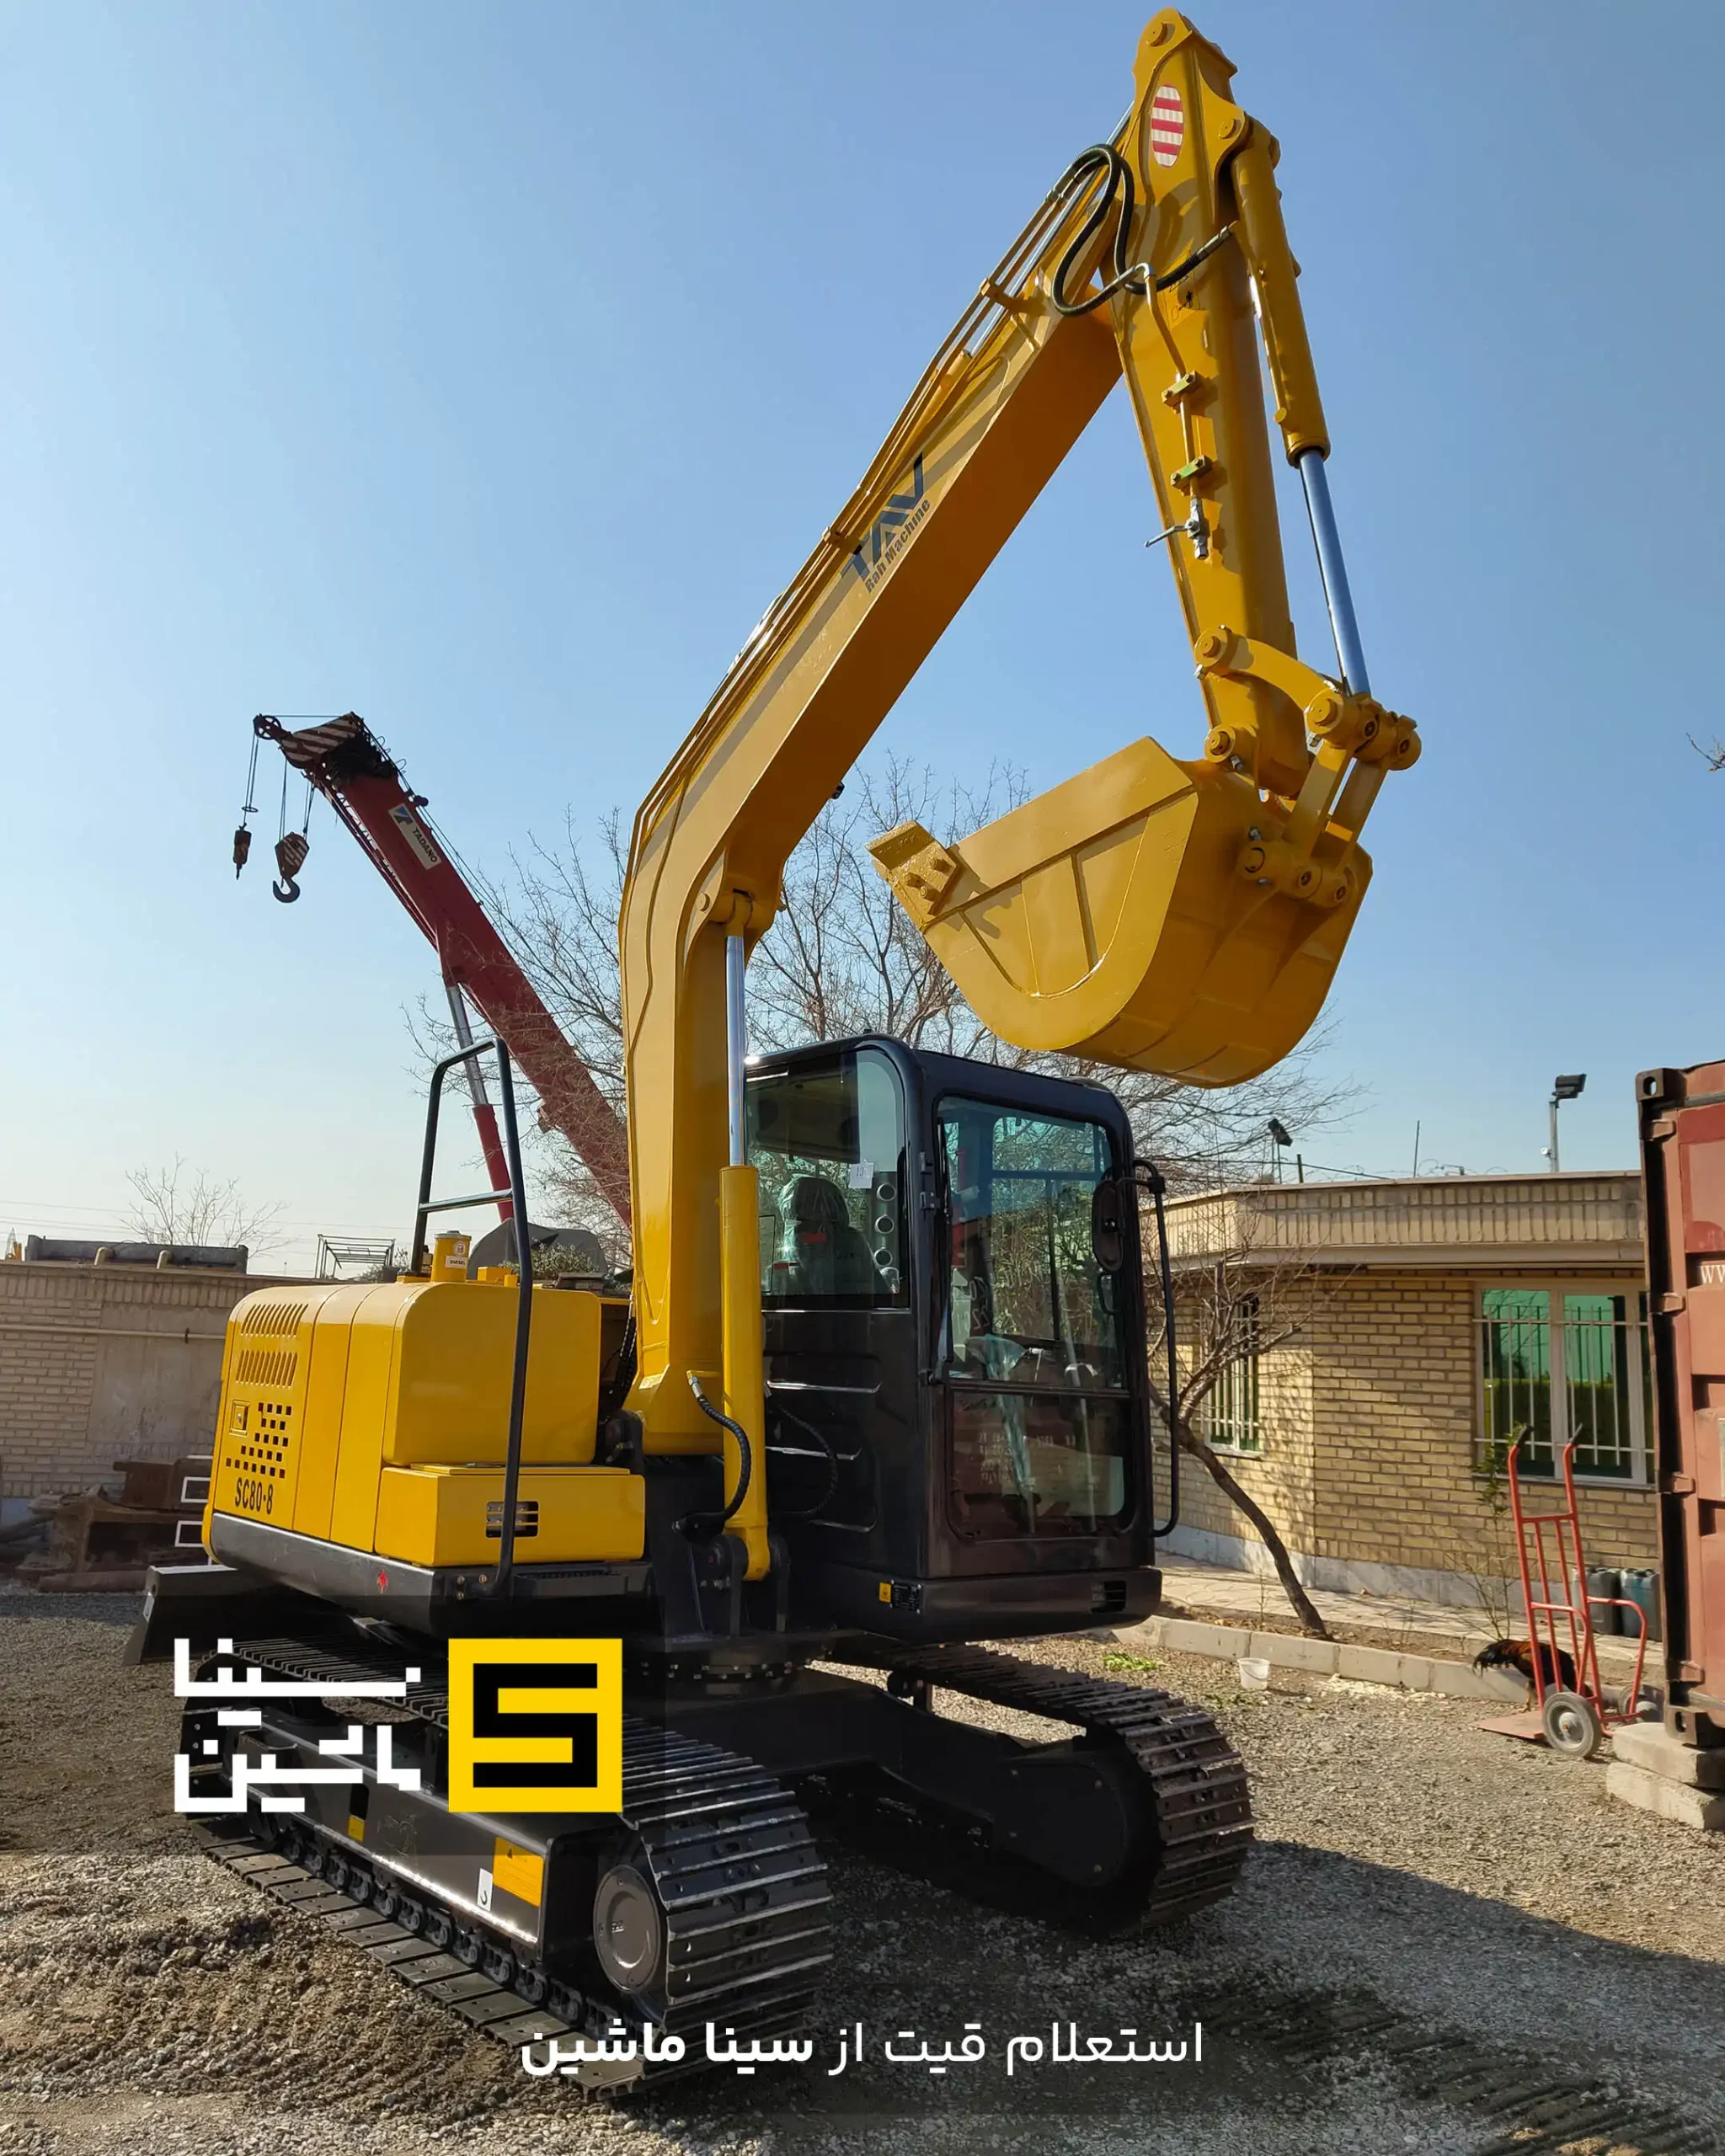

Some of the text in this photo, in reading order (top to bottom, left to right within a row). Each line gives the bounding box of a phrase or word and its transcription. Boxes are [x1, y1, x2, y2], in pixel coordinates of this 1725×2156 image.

[864, 499, 931, 594] Rah Machine
[412, 826, 438, 863] TADANO
[234, 1477, 274, 1515] SC80-8
